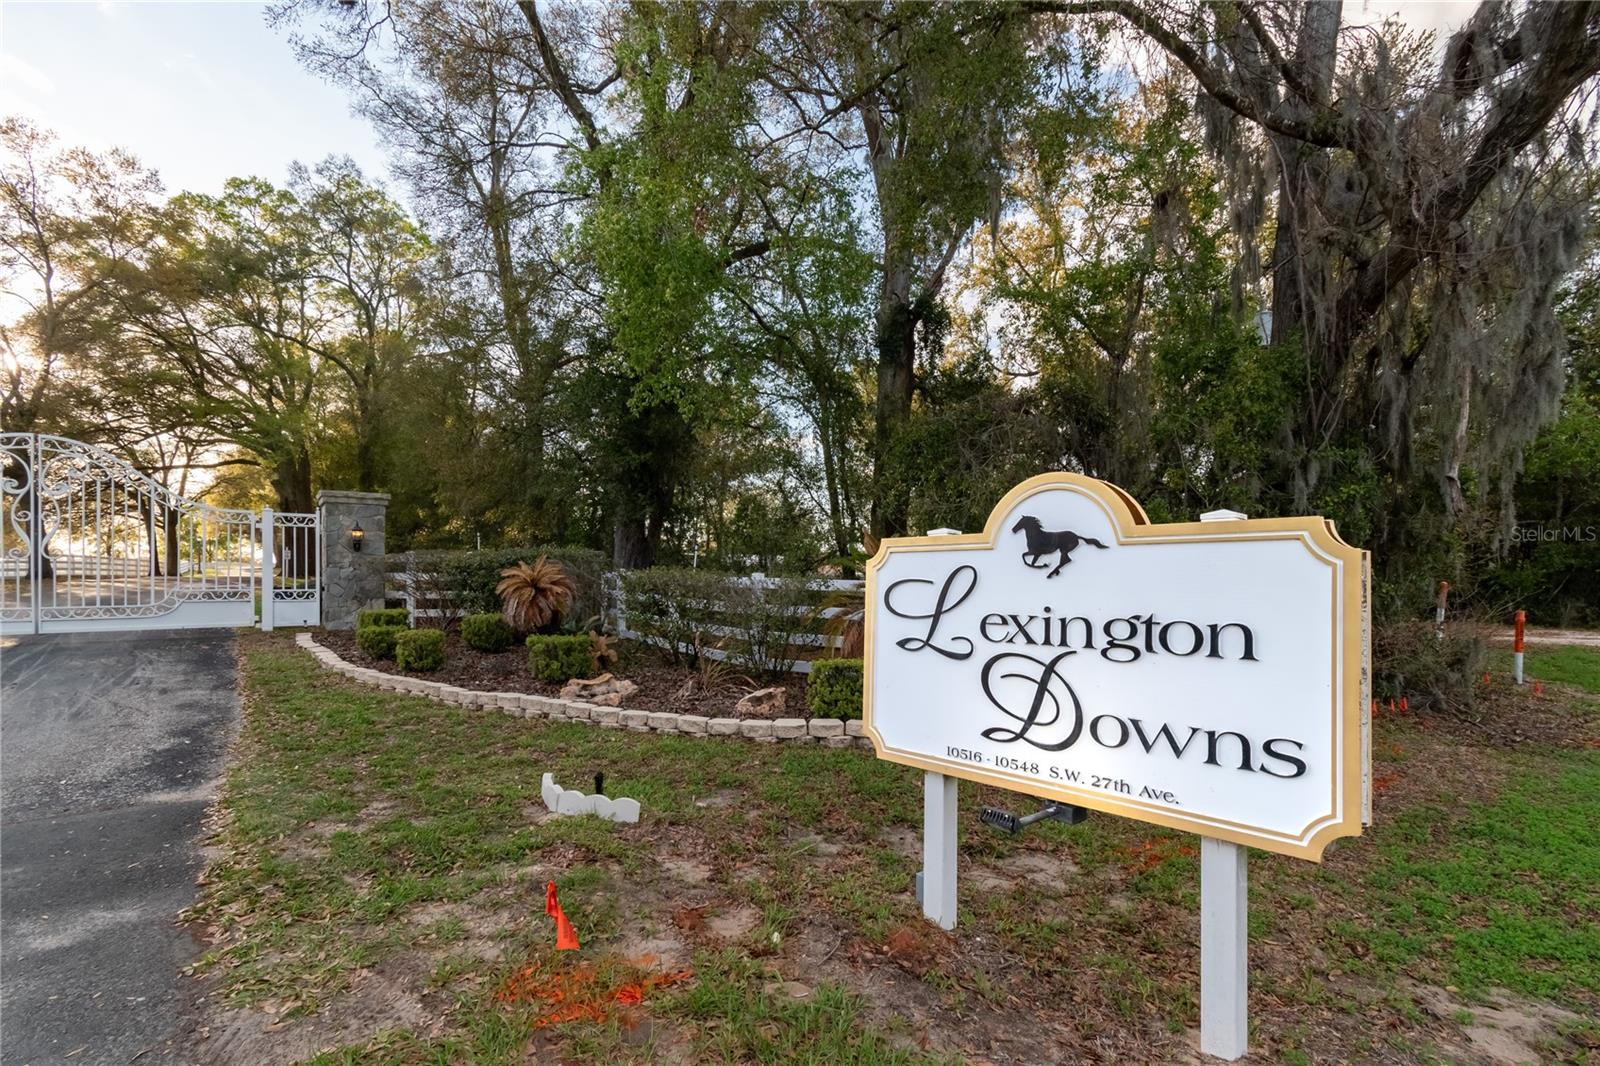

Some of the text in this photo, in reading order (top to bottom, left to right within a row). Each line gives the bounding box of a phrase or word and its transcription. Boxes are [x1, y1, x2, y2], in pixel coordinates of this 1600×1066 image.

[883, 564, 1260, 664] Lexington
[980, 650, 1307, 780] Downs
[946, 746, 983, 763] 10516
[995, 755, 1040, 775] 10548
[1049, 766, 1086, 785] S.W.
[1091, 775, 1132, 795] 27th
[1138, 785, 1181, 805] Ave.
